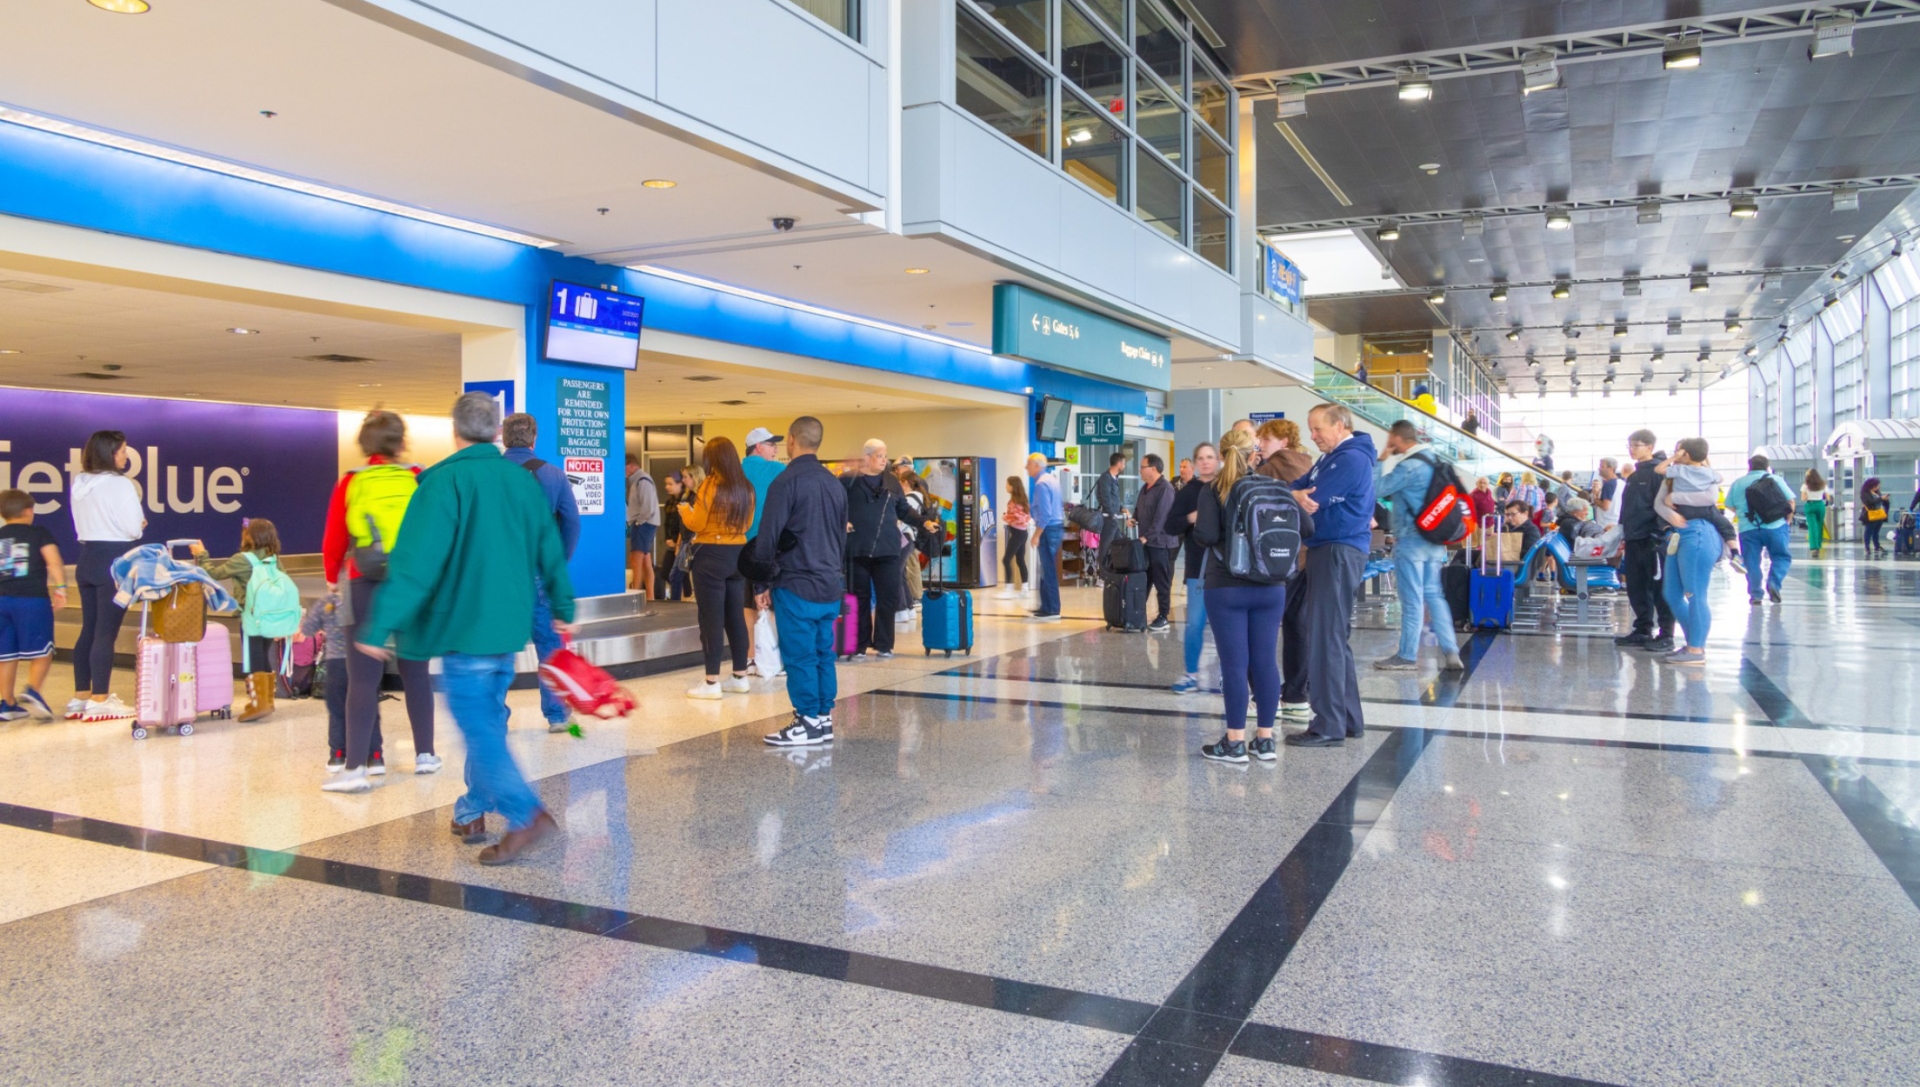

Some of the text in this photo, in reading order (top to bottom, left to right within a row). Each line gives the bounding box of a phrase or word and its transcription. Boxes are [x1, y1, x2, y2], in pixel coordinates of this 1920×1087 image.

[557, 288, 568, 314] 1
[1053, 319, 1068, 335] Gates
[563, 378, 605, 391] PASSENGERS
[577, 390, 591, 399] ARE
[557, 407, 609, 420] FOR YOUR OWN
[560, 428, 607, 438] NEVER LEAVE
[568, 437, 600, 447] BAGGAGE
[560, 447, 607, 457] UNATTENDED
[568, 460, 601, 471] NOTICE
